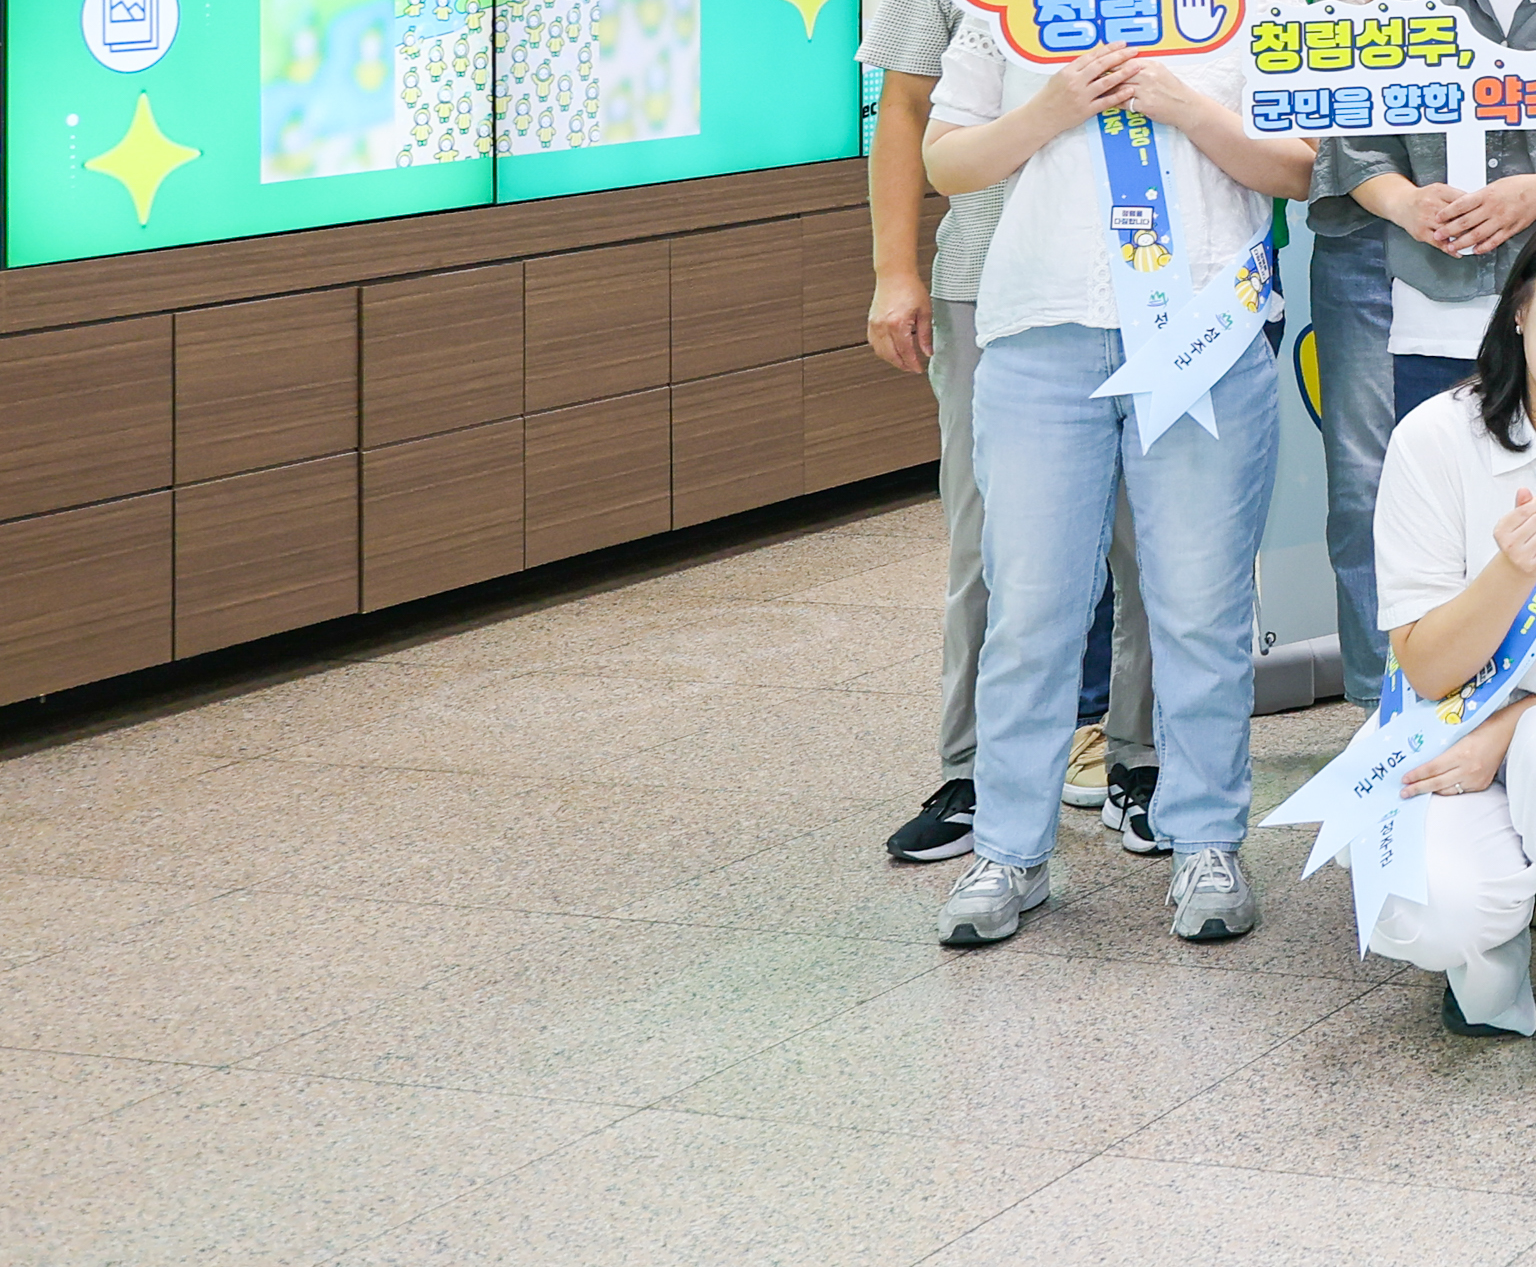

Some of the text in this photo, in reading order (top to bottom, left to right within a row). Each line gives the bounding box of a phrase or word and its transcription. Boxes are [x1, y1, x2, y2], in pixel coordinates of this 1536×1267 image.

[1250, 16, 1475, 74] 청렴성주,
[1252, 85, 1374, 132] 군민을
[1381, 82, 1465, 127] 향한
[1172, 326, 1221, 371] 성주군
[1351, 749, 1407, 801] 성주군
[1379, 820, 1395, 871] 성주군
